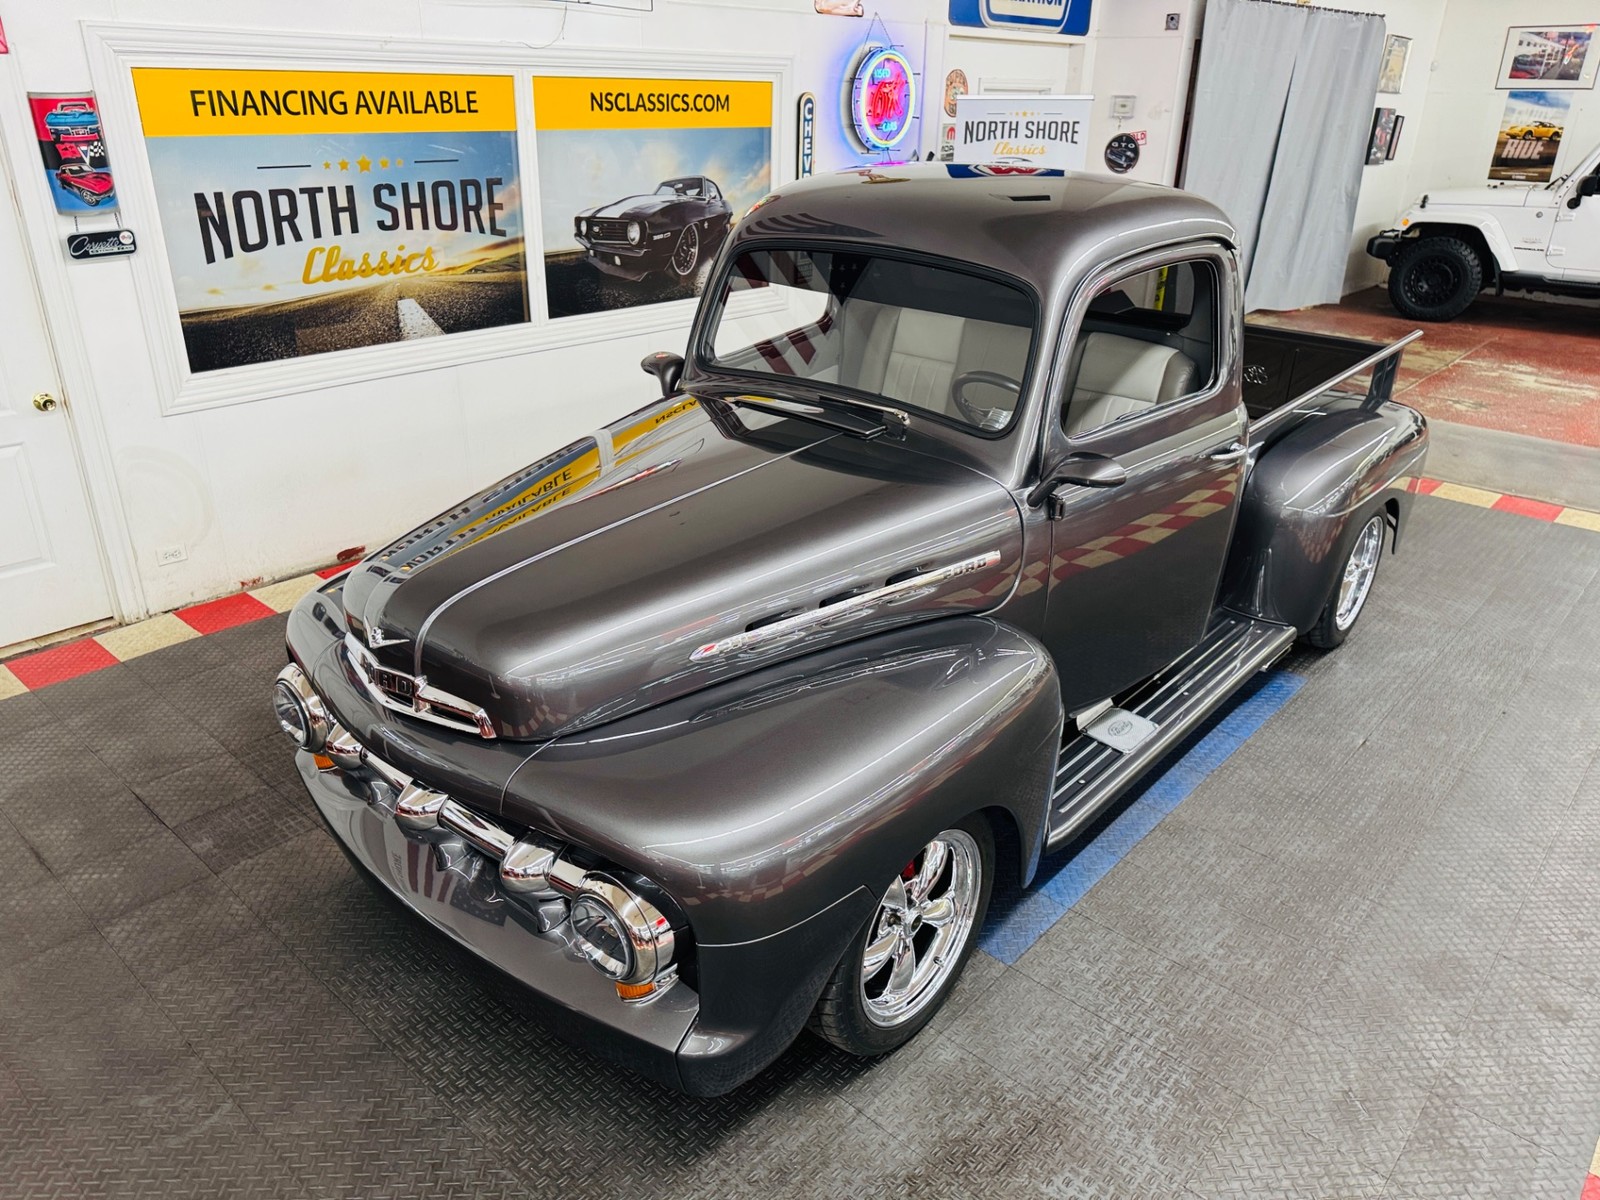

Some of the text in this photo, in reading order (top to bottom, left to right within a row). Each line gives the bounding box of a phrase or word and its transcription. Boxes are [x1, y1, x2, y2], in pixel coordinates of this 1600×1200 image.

[189, 89, 479, 117] FINANCING AVAILABLE
[590, 92, 730, 112] NSCLASSICS.COM
[803, 102, 813, 178] CHEV
[963, 120, 1081, 145] NORTH SHORE
[993, 141, 1047, 156] Classics
[1111, 141, 1136, 149] GTO
[1501, 139, 1545, 160] RIDE
[193, 177, 507, 265] NORTH SHORE
[70, 236, 122, 256] Corvette
[302, 244, 440, 285] Classics
